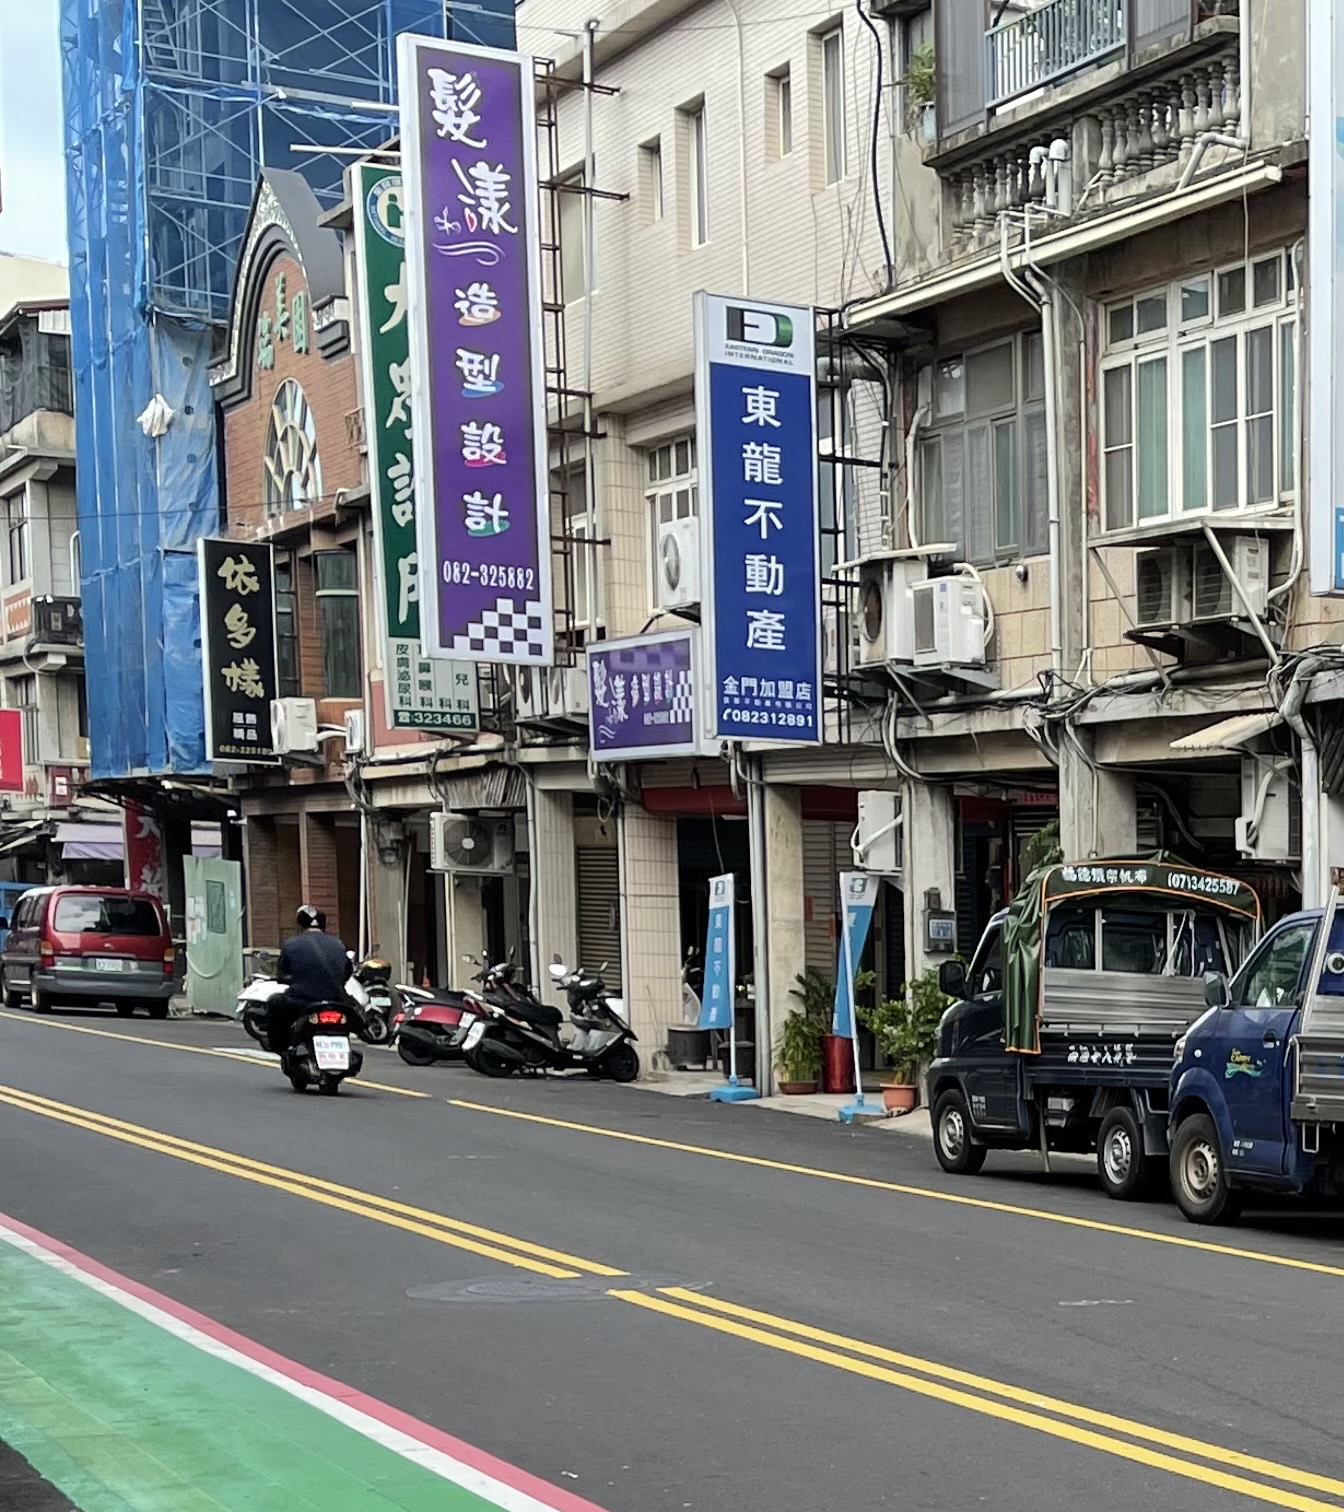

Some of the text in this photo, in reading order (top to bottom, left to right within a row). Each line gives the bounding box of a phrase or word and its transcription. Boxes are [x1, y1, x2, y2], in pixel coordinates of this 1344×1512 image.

[454, 281, 509, 535] 造型設計
[741, 385, 786, 651] 東龍不動產
[443, 559, 535, 591] 082-325882
[722, 675, 813, 701] 金門加盟店
[414, 712, 472, 726] 323466
[732, 708, 814, 728] 082312891
